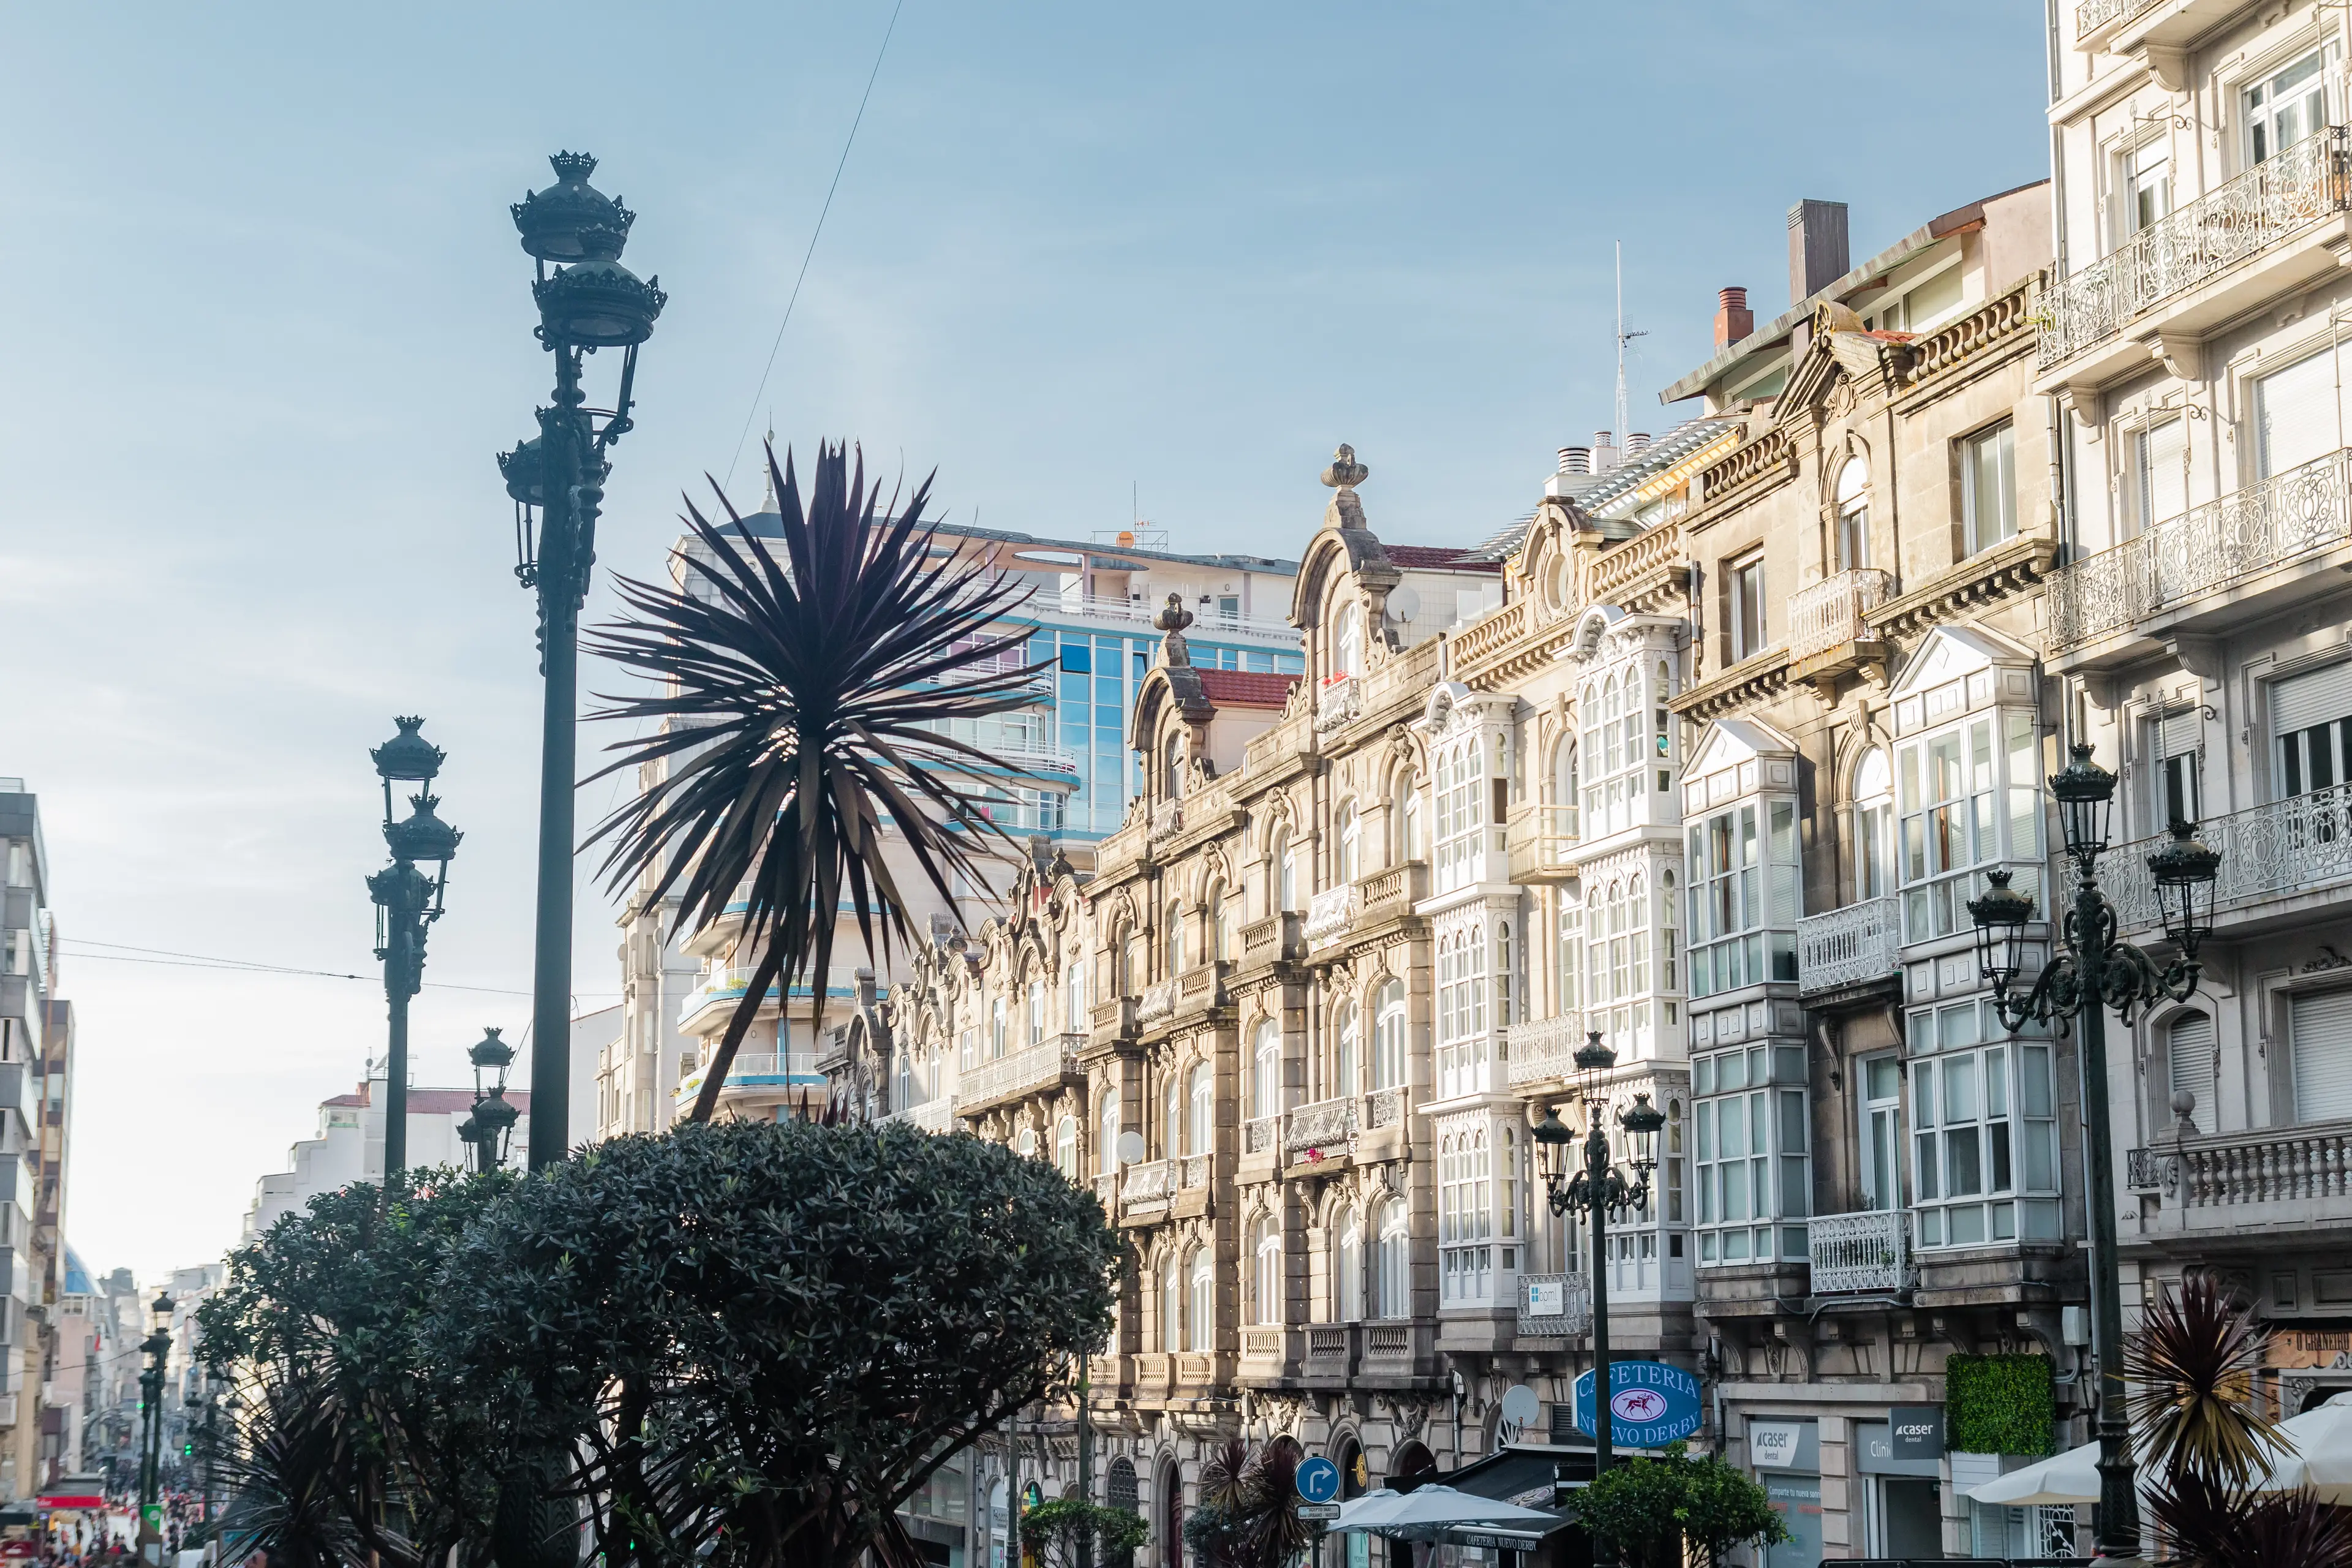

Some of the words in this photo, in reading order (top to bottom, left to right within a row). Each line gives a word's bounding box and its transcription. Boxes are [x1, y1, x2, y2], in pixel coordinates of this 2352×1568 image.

[2296, 1332, 2302, 1351] O
[2305, 1332, 2350, 1351] GRANEIRO
[1644, 1411, 1698, 1443] DERBY
[1902, 1424, 1933, 1435] caser
[1763, 1432, 1788, 1447] caser
[1765, 1450, 1779, 1460] dental
[1768, 1485, 1789, 1498] Comparte
[1790, 1488, 1795, 1497] tu
[1796, 1489, 1809, 1498] nueva
[1466, 1534, 1496, 1547] CAFETERIA
[1498, 1537, 1517, 1549] NUEVO
[1518, 1539, 1537, 1551] DERBY
